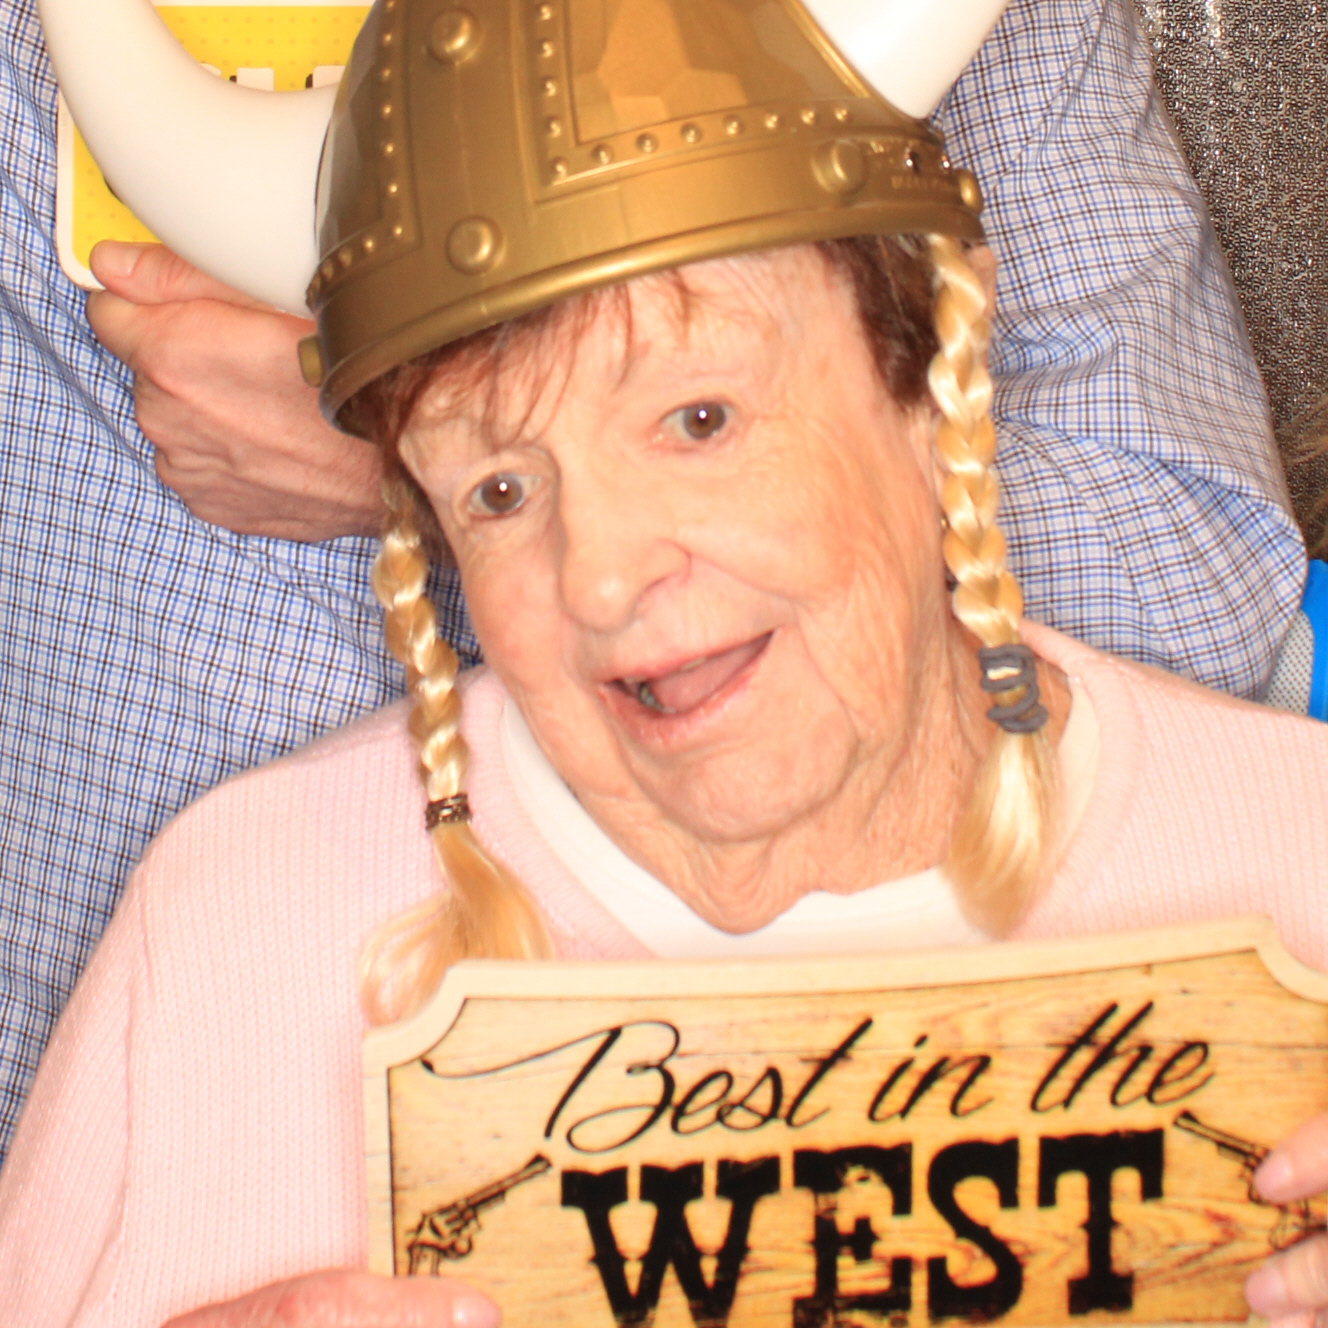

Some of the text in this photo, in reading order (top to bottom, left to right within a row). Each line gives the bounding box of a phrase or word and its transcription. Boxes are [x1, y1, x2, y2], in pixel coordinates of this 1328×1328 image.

[422, 1001, 1213, 1153] Best in the
[561, 1128, 1165, 1328] WEST
